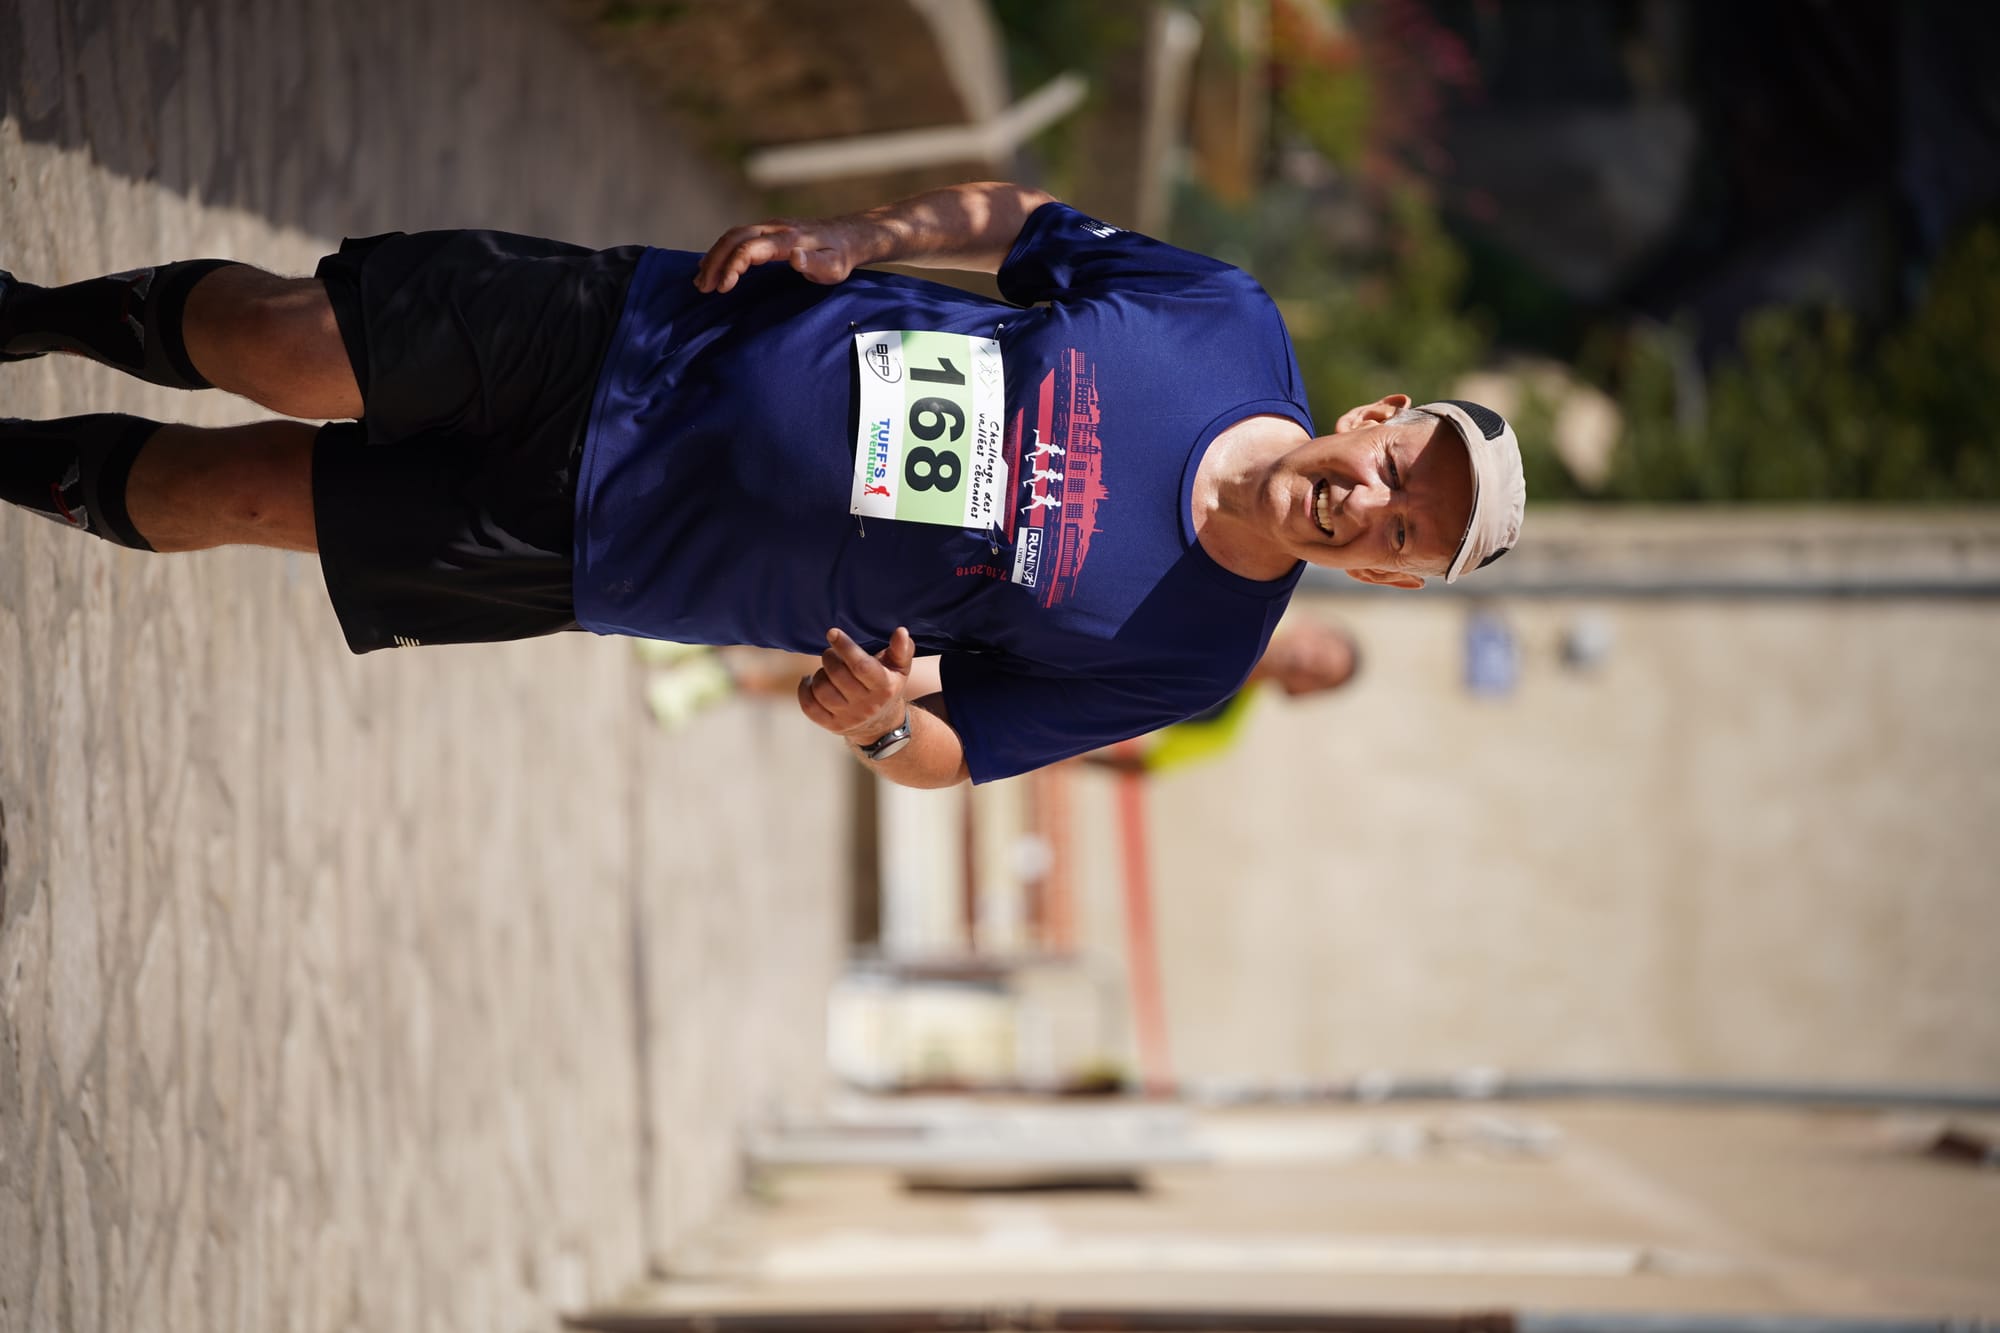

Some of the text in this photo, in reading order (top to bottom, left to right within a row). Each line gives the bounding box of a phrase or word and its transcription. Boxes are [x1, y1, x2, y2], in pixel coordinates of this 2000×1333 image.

[876, 344, 890, 377] BFP
[865, 422, 882, 484] Aventure
[874, 417, 891, 478] TUFF'S
[904, 357, 966, 493] 168
[970, 412, 989, 519] vallées cévenoles
[983, 421, 1000, 515] Challenge des
